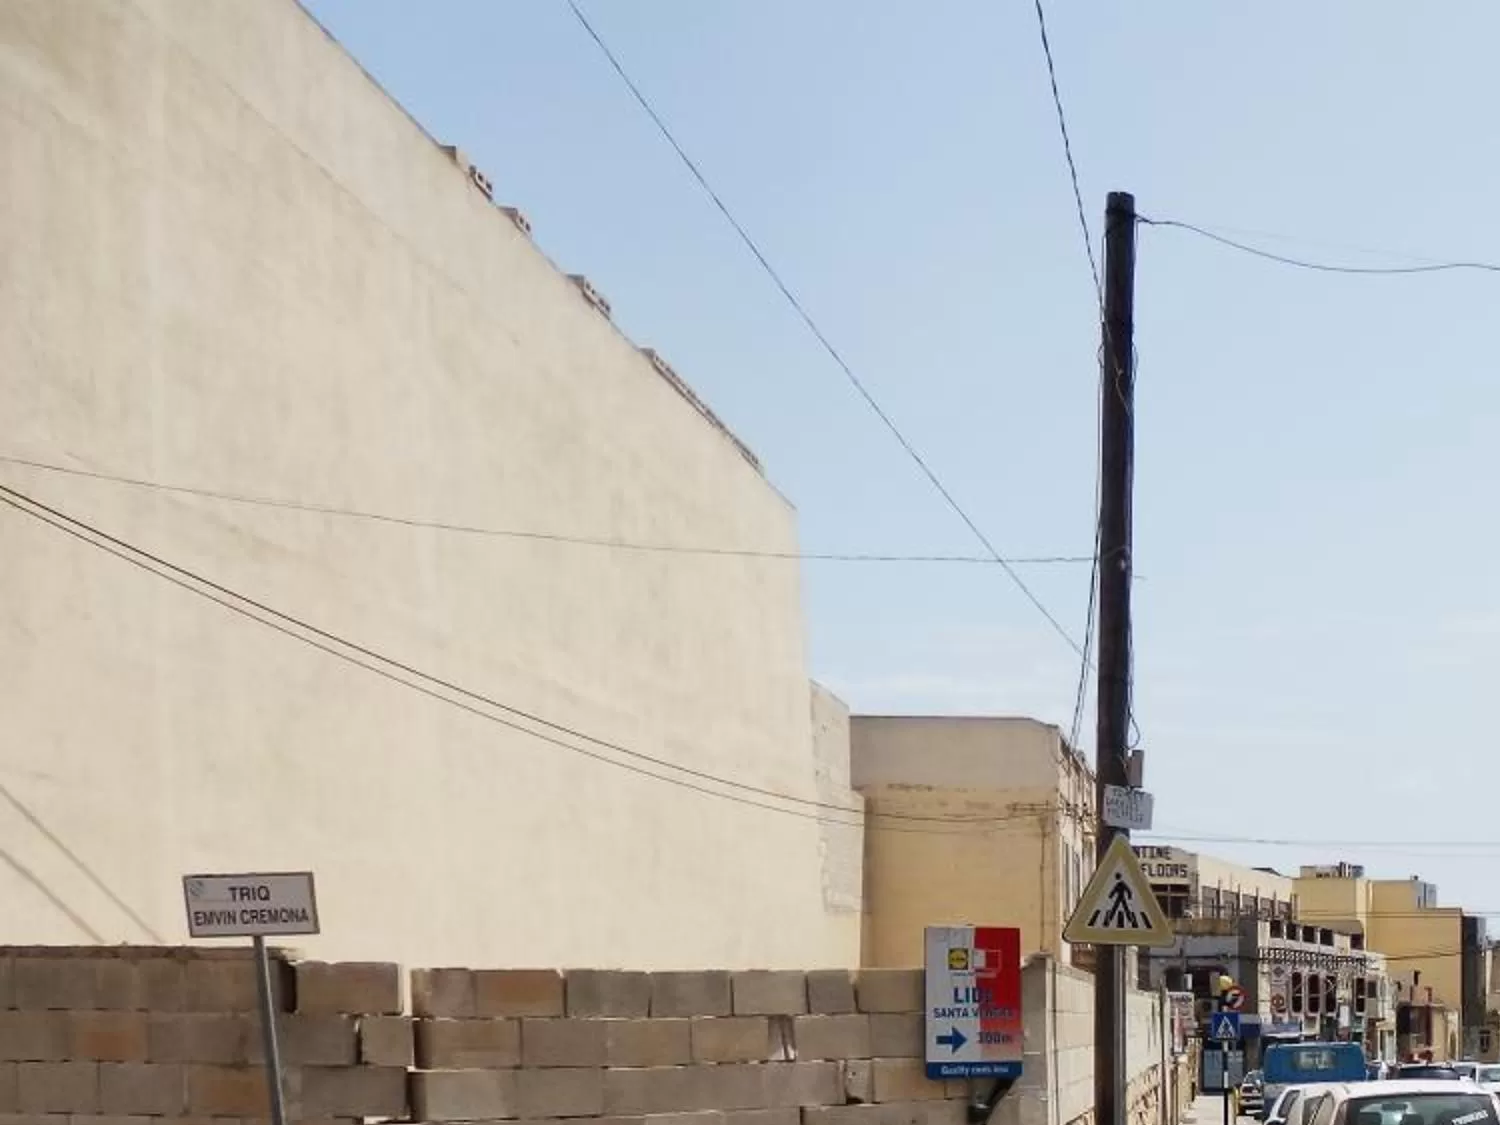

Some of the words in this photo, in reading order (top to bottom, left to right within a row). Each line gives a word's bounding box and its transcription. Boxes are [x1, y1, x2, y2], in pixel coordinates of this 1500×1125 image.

[228, 885, 271, 901] TRIQ
[193, 910, 237, 926] EMVIN
[240, 907, 309, 925] CREMONA
[933, 1007, 968, 1019] SANTA
